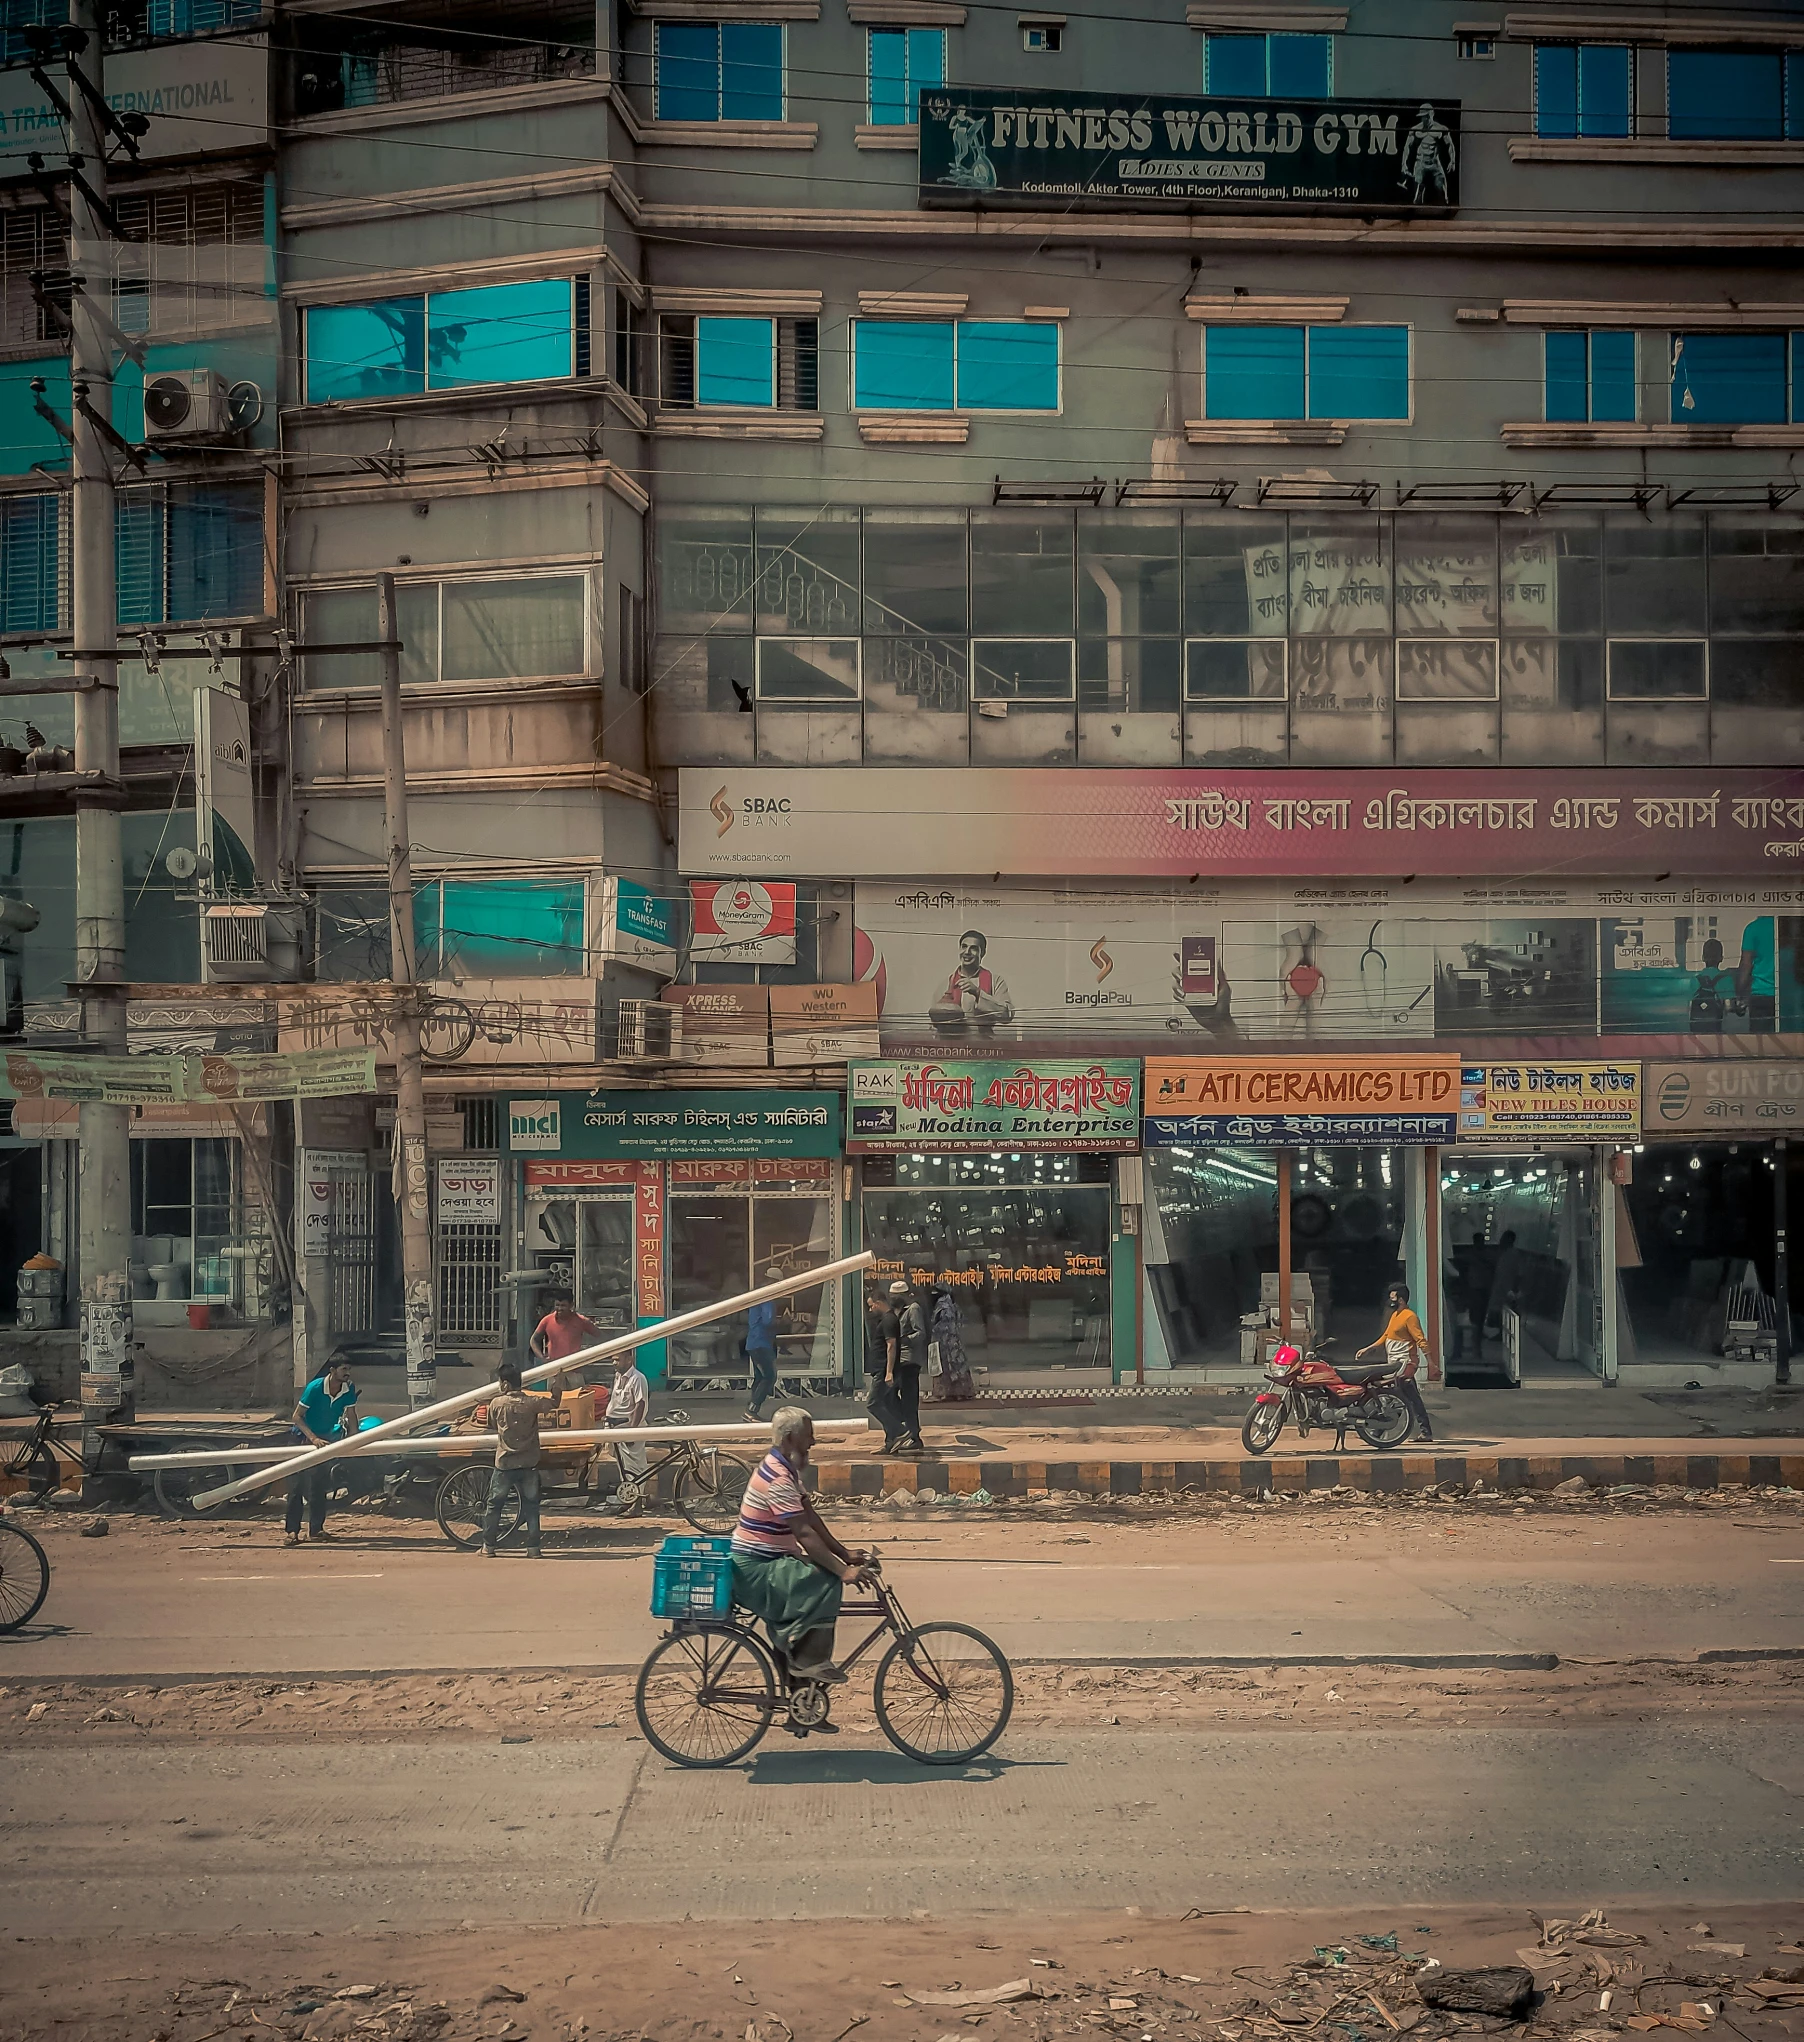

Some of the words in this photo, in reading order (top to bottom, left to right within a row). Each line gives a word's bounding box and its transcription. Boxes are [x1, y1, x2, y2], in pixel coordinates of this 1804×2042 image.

[991, 107, 1152, 151] FITNESS
[1162, 110, 1303, 153] WORLD
[1313, 113, 1399, 154] GYM
[1121, 159, 1185, 176] LADIES
[1188, 163, 1202, 177] &
[1206, 163, 1264, 178] GENTS
[1087, 183, 1119, 195] Akter
[1121, 184, 1159, 197] Tower,
[1161, 184, 1184, 197] (4th
[1292, 186, 1359, 198] Dhaka-1310
[1253, 549, 1280, 579] প্রতি
[1518, 583, 1547, 604] জন্য
[743, 798, 792, 814] SBAC
[1164, 790, 1252, 831] সাউথ
[1262, 798, 1352, 831] বাংলা
[1362, 788, 1538, 831] এগ্রিকালচার
[1549, 797, 1622, 830] এ্যান্ড
[1632, 788, 1722, 830] কমার্স
[742, 815, 792, 827] BANK
[708, 853, 791, 862] www.sbacbank.com
[894, 890, 956, 910] এসবিএসি
[1597, 890, 1634, 905] সাউথ
[1638, 891, 1677, 904] বাংলা
[1681, 888, 1756, 904] এগ্রিকালচার
[1762, 890, 1792, 903] এ্যান্ড
[627, 908, 667, 931] TRANSFAST
[718, 911, 765, 920] MoneyGram
[738, 943, 763, 951] SBAC
[687, 994, 737, 1006] XPRESS
[813, 989, 834, 999] WU
[1065, 990, 1133, 1007] BanglaPay
[801, 1002, 847, 1012] Western
[857, 1073, 894, 1088] RAK
[1198, 1073, 1242, 1103] ATI
[1247, 1071, 1394, 1103] CERAMICS
[1399, 1070, 1452, 1102] LTD
[1489, 1067, 1522, 1093] নিউ
[1526, 1067, 1584, 1098] টাইলস্
[1588, 1066, 1638, 1095] হাউজ
[1705, 1069, 1761, 1096] SUN
[900, 1065, 976, 1117] মদিনা
[982, 1065, 1135, 1117] এন্টারপ্রাইজ
[1488, 1100, 1527, 1112] NEW
[1531, 1099, 1578, 1112] TILES
[1582, 1098, 1638, 1112] HOUSE
[1755, 1099, 1798, 1119] ট্রেড
[512, 1111, 558, 1135] mcl
[583, 1109, 627, 1127] মেসার্স
[632, 1112, 680, 1127] মারুফ
[683, 1108, 732, 1131] টাইলস্
[763, 1106, 828, 1127] স্যানিটারী
[856, 1119, 882, 1127] star
[900, 1121, 917, 1133] New
[916, 1117, 1003, 1134] Modina
[1010, 1115, 1134, 1137] Enterprise
[1153, 1114, 1220, 1137] অর্পন
[1225, 1114, 1278, 1138] ট্রেড
[1282, 1113, 1451, 1136] ইন্টারন্যাশনাল
[529, 1160, 633, 1180] মাসুদ
[673, 1158, 747, 1178] মারুফ
[755, 1157, 828, 1179] টাইলস্
[440, 1176, 496, 1195] ভাড়া
[440, 1198, 472, 1208] দেওয়া
[474, 1198, 496, 1208] হবে
